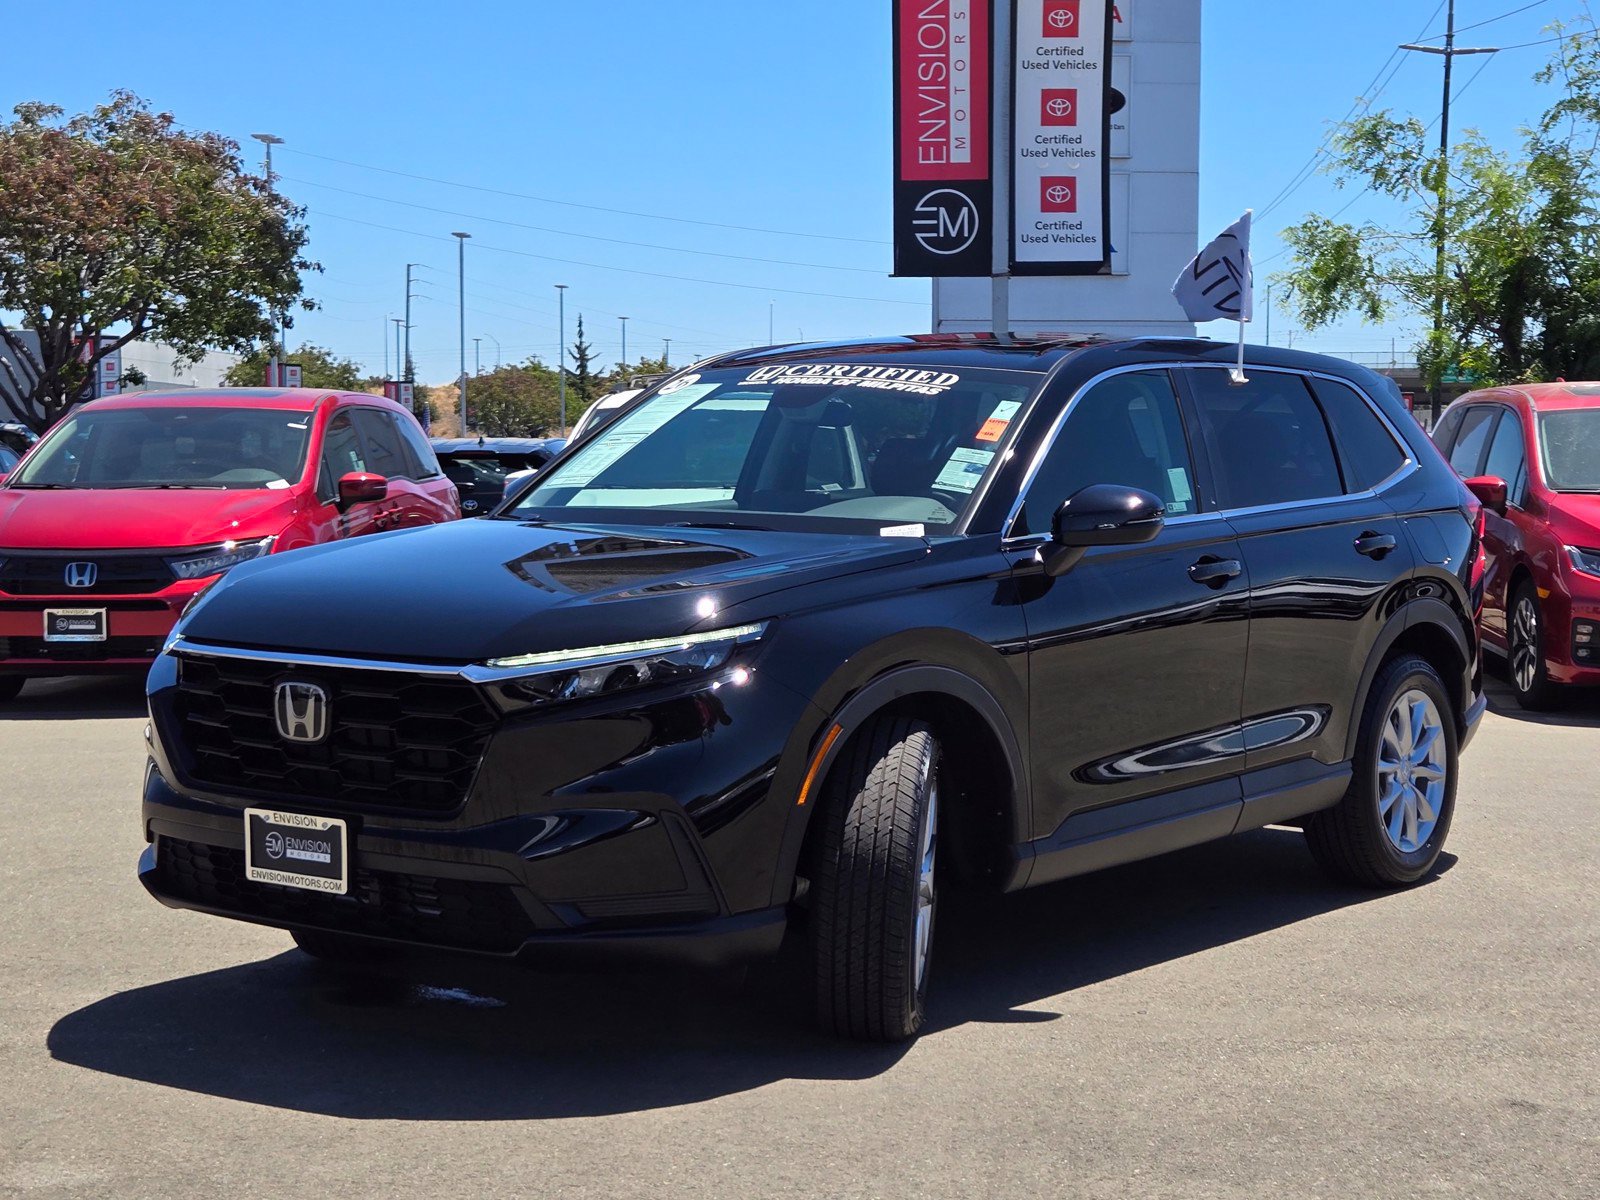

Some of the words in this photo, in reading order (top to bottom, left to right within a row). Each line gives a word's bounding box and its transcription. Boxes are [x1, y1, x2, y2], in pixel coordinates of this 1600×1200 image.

[1036, 46, 1085, 56] Certified
[1022, 59, 1050, 70] Used
[1052, 59, 1098, 70] Vehicles
[918, 0, 947, 164] ENVISION
[954, 11, 966, 150] MOTORS
[1034, 134, 1082, 144] Certified
[1021, 148, 1048, 158] Used
[1051, 148, 1096, 158] Vehicles
[1035, 220, 1083, 230] Certified
[1021, 234, 1049, 244] Used
[1051, 234, 1097, 244] Vehicles
[785, 364, 960, 386] CERTIFIED
[771, 377, 832, 385] HONDA
[832, 378, 861, 386] OF
[856, 380, 943, 395] MILPITAS
[273, 812, 318, 827] ENVISION
[286, 837, 331, 853] ENVISION
[251, 869, 342, 891] ENVISIONMOTORS.COM
